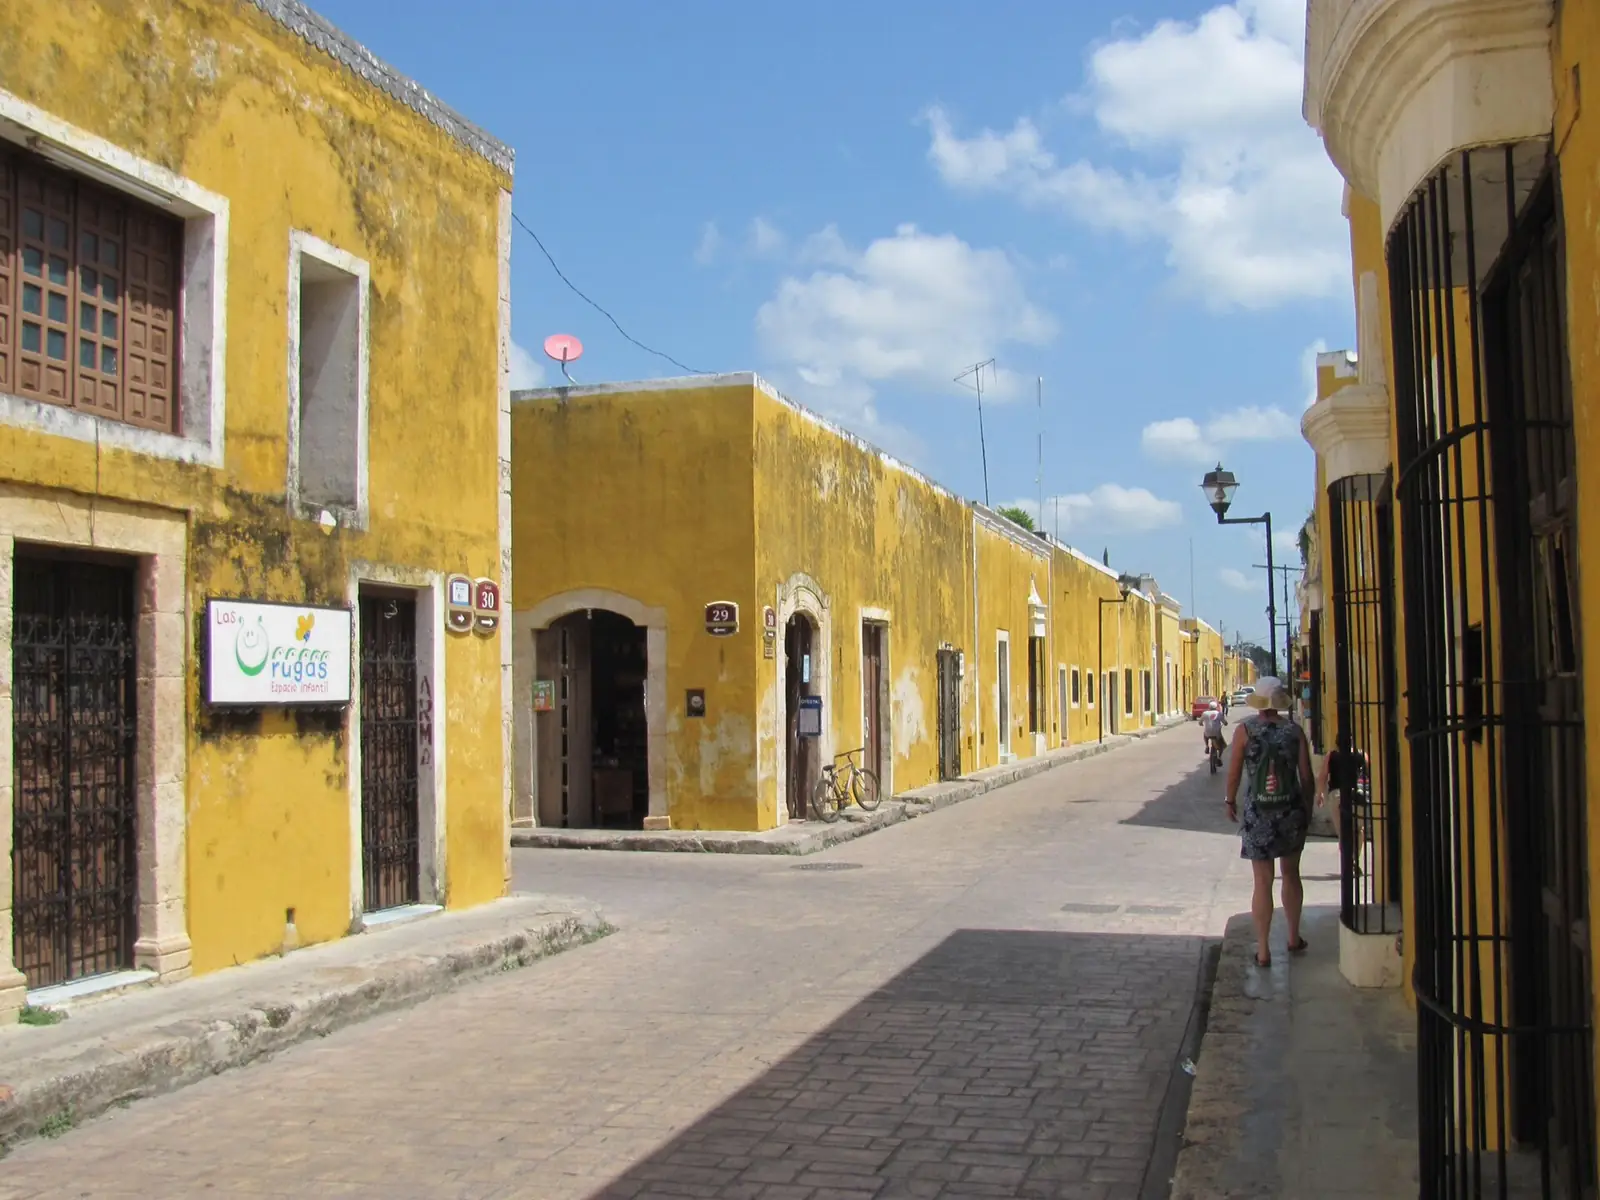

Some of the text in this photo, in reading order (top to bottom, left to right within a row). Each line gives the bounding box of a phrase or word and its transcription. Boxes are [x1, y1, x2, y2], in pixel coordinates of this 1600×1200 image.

[482, 591, 494, 609] 30
[216, 608, 236, 625] Las
[712, 610, 729, 622] 29
[271, 681, 328, 694] Espacio infantil
